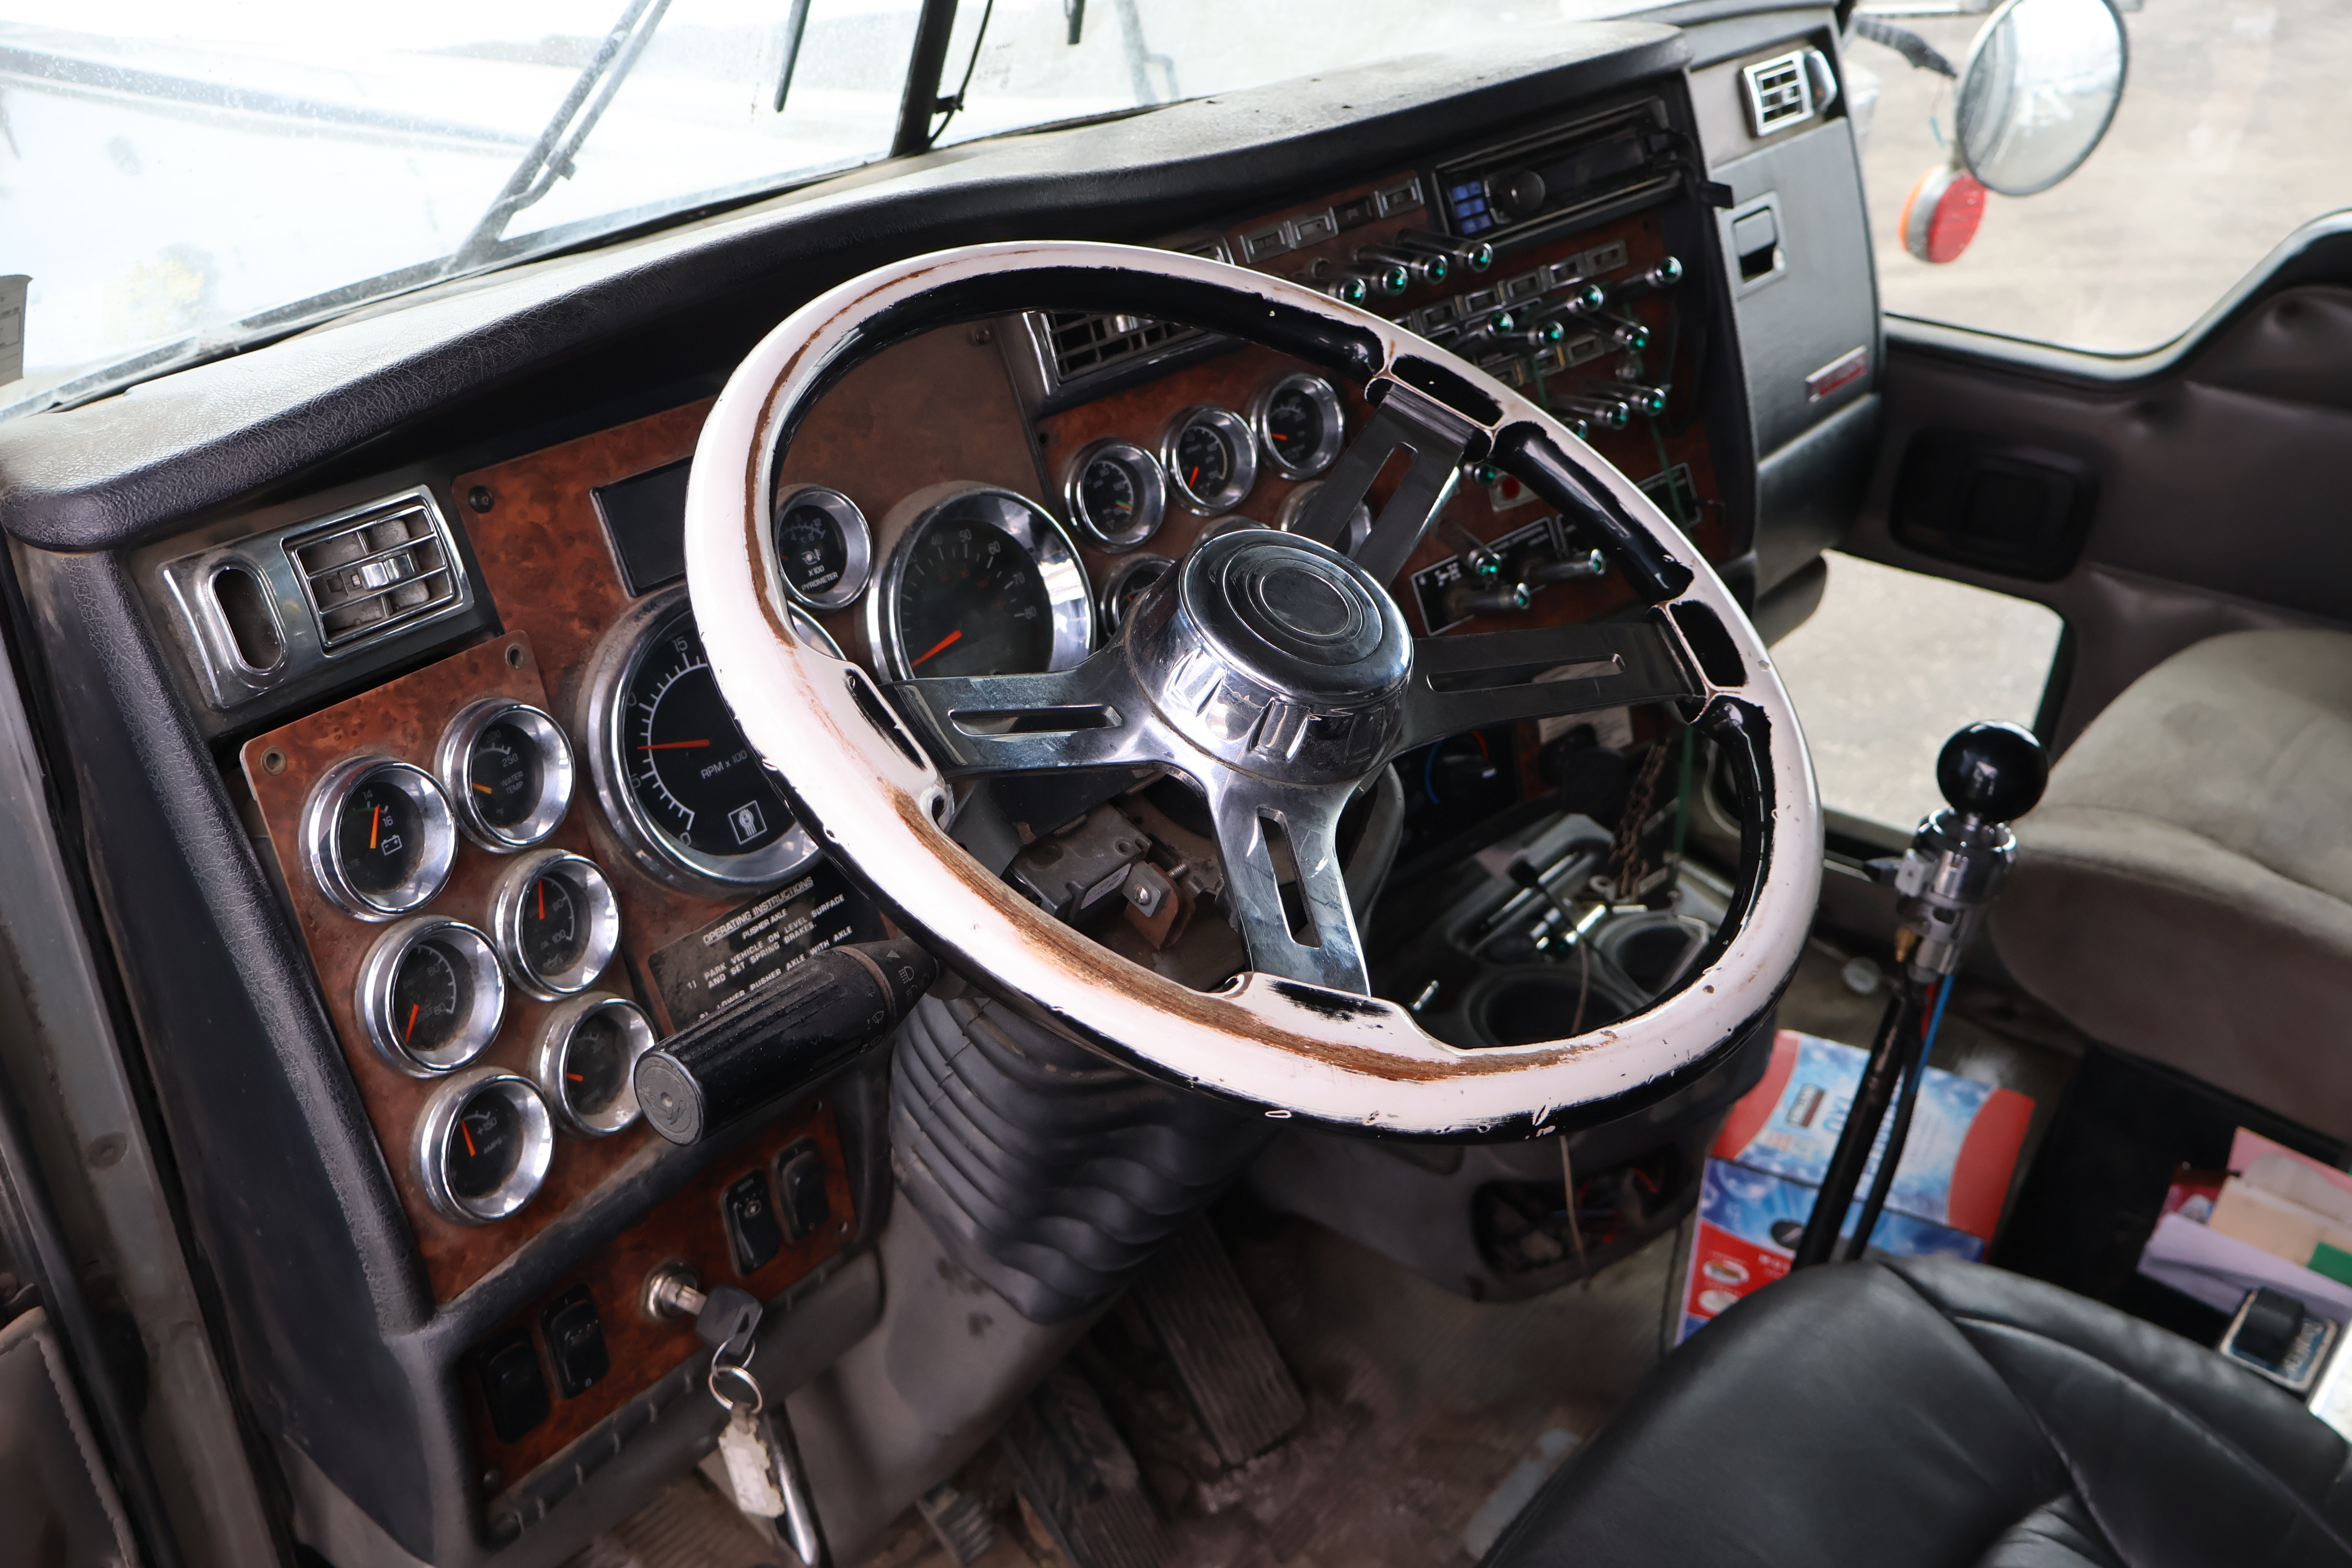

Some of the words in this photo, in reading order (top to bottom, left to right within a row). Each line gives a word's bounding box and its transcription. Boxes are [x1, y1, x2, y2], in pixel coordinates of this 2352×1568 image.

[801, 571, 838, 591] PYROMETER
[671, 636, 688, 653] 15
[501, 753, 519, 768] 250
[701, 760, 724, 780] RPM
[731, 749, 748, 764] 100
[500, 770, 524, 788] WATER
[506, 780, 523, 795] TEMP
[382, 815, 394, 828] 16
[702, 910, 752, 946] OPERATING
[751, 876, 814, 918] INSTRUCTIONS
[741, 918, 771, 939] PUSHER
[769, 908, 788, 924] AXLE
[704, 962, 727, 980] PARK
[730, 940, 764, 965] VEHICLE
[768, 931, 780, 942] ON
[784, 916, 808, 934] LEVEL
[810, 893, 845, 919] SURFACE
[707, 973, 726, 989] AND
[730, 961, 746, 976] SET
[749, 942, 780, 965] SPRING
[749, 968, 782, 991] PUSHER
[786, 954, 806, 971] AXLE
[809, 940, 830, 956] WITH
[833, 926, 853, 943] AXLE
